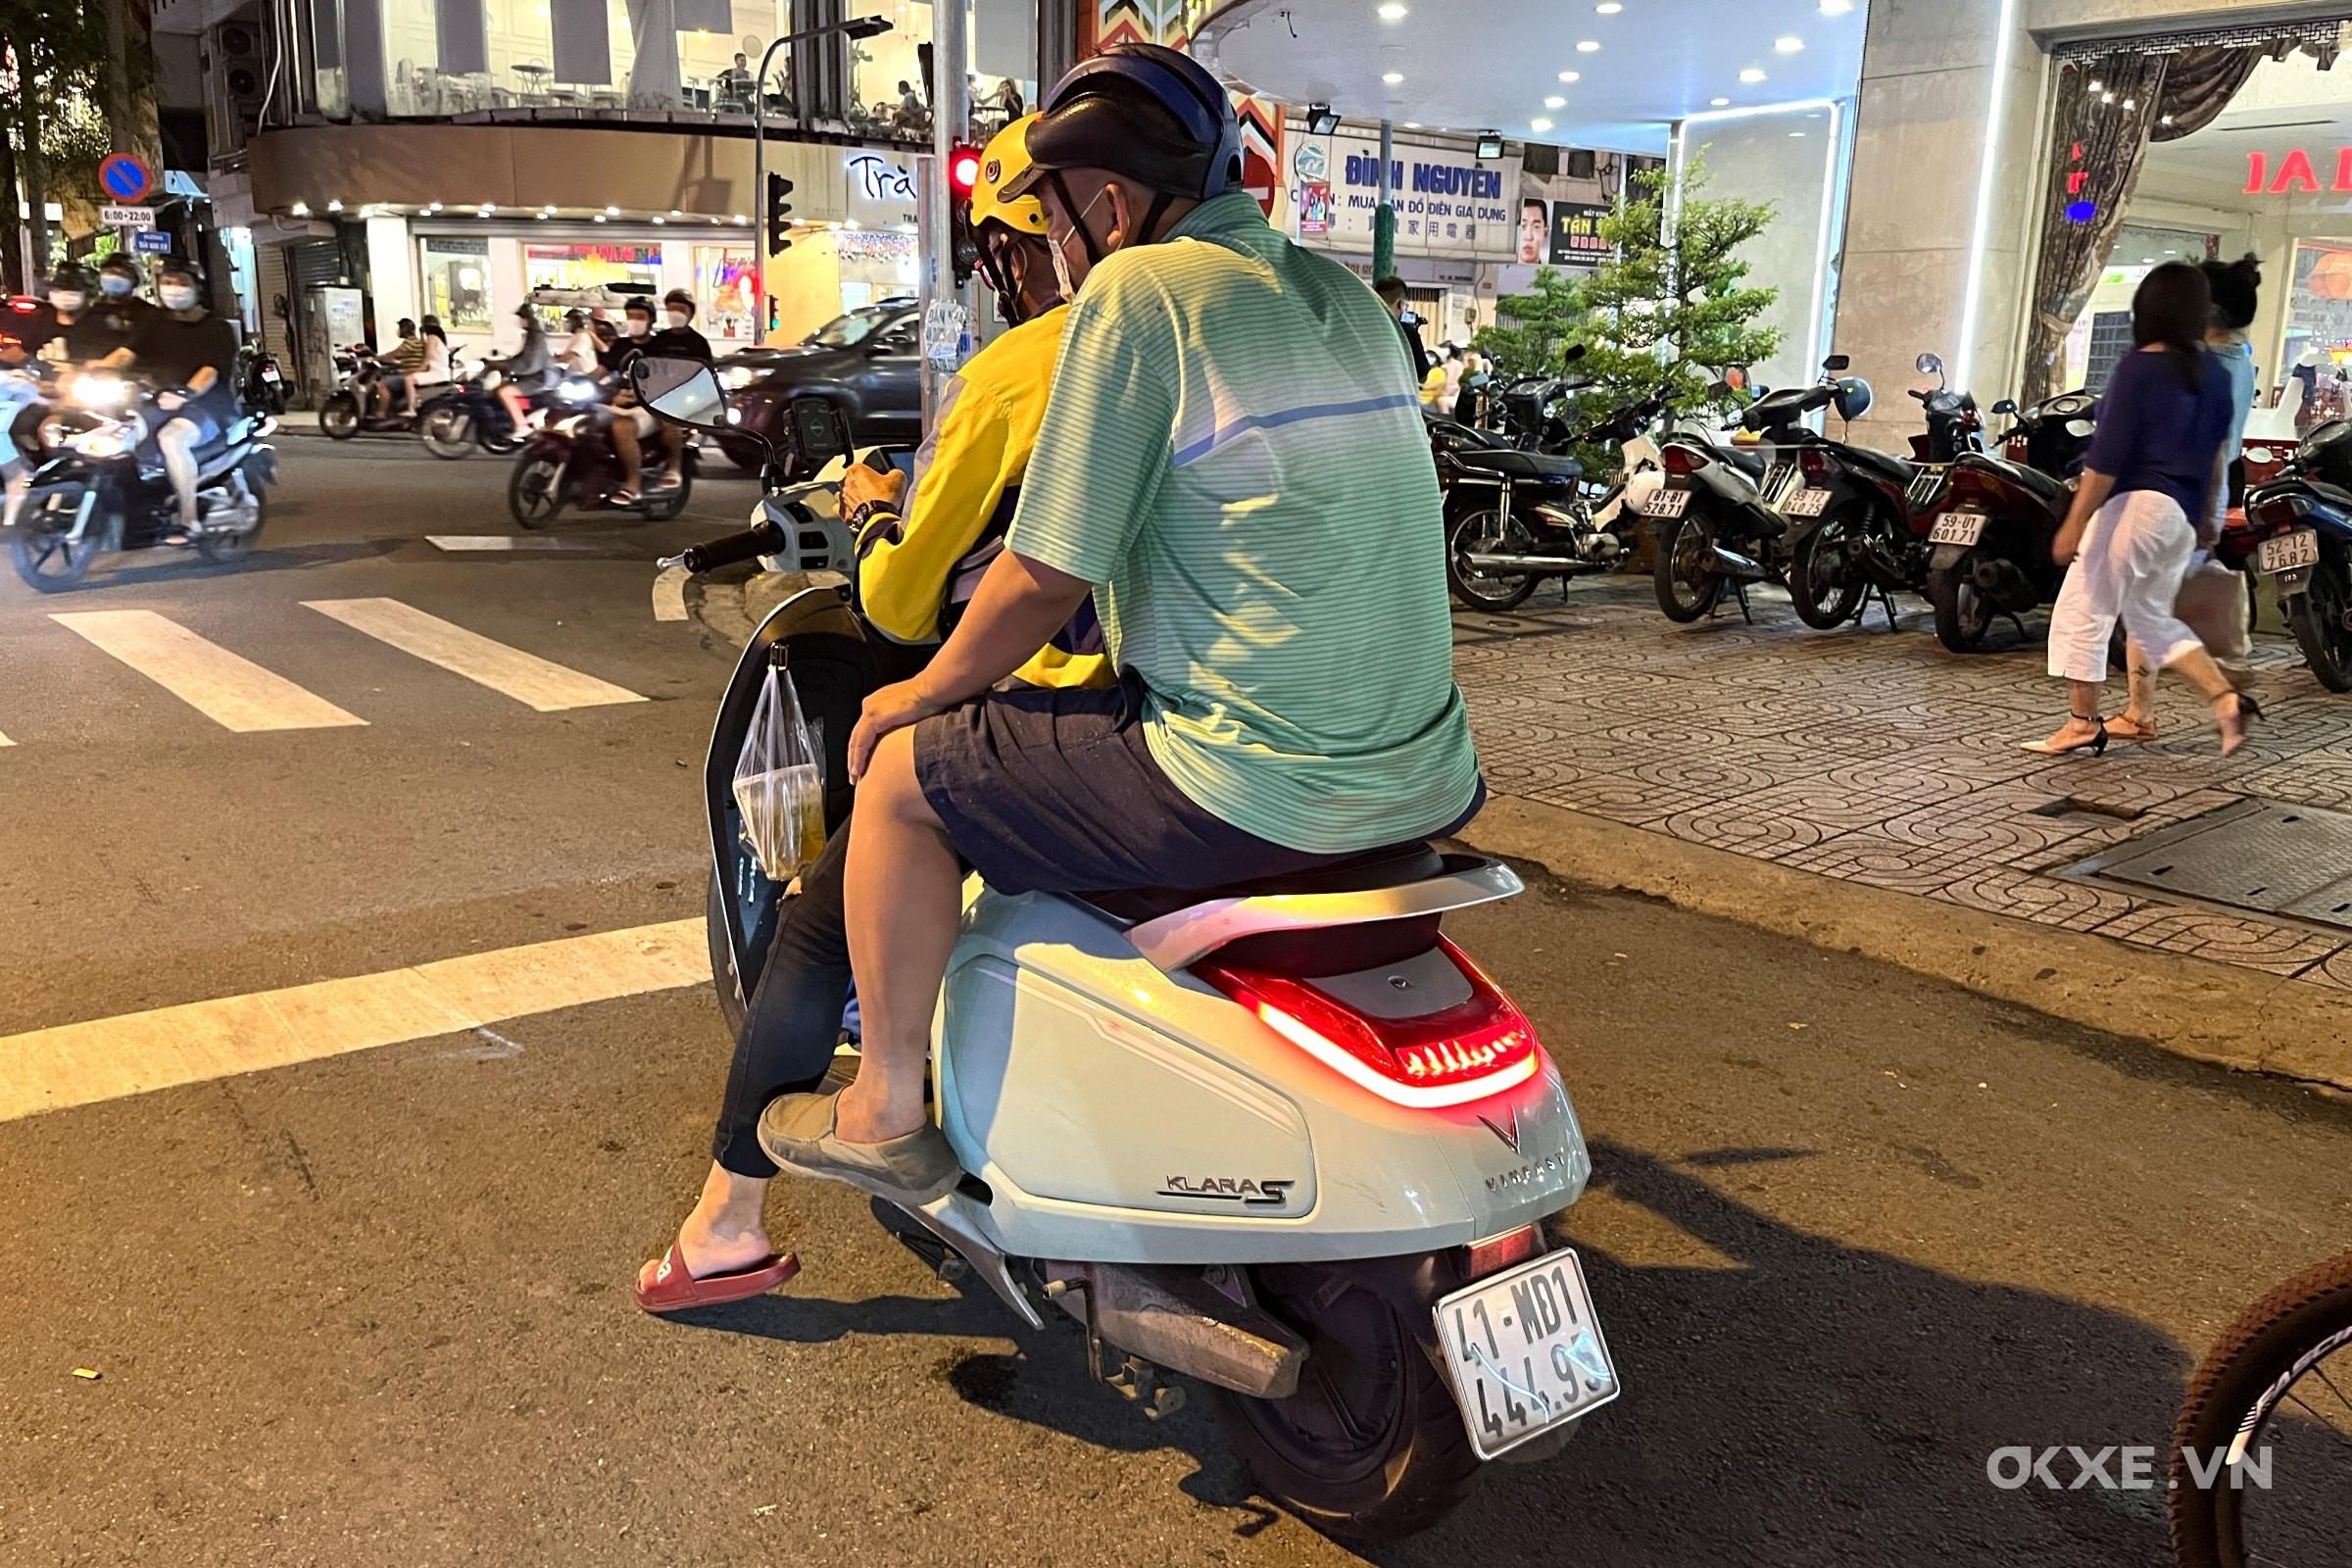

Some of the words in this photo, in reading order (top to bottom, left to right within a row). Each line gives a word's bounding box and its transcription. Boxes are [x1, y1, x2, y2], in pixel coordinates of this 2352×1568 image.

[850, 156, 917, 199] Trà
[1412, 162, 1501, 199] NGUYÊN
[1348, 195, 1375, 210] MUA
[1456, 206, 1474, 219] GIA
[1643, 502, 1683, 516] 528.71
[1942, 515, 1977, 530] 59-U1
[1933, 528, 1976, 543] 601.71
[1166, 1175, 1260, 1195] KLARA
